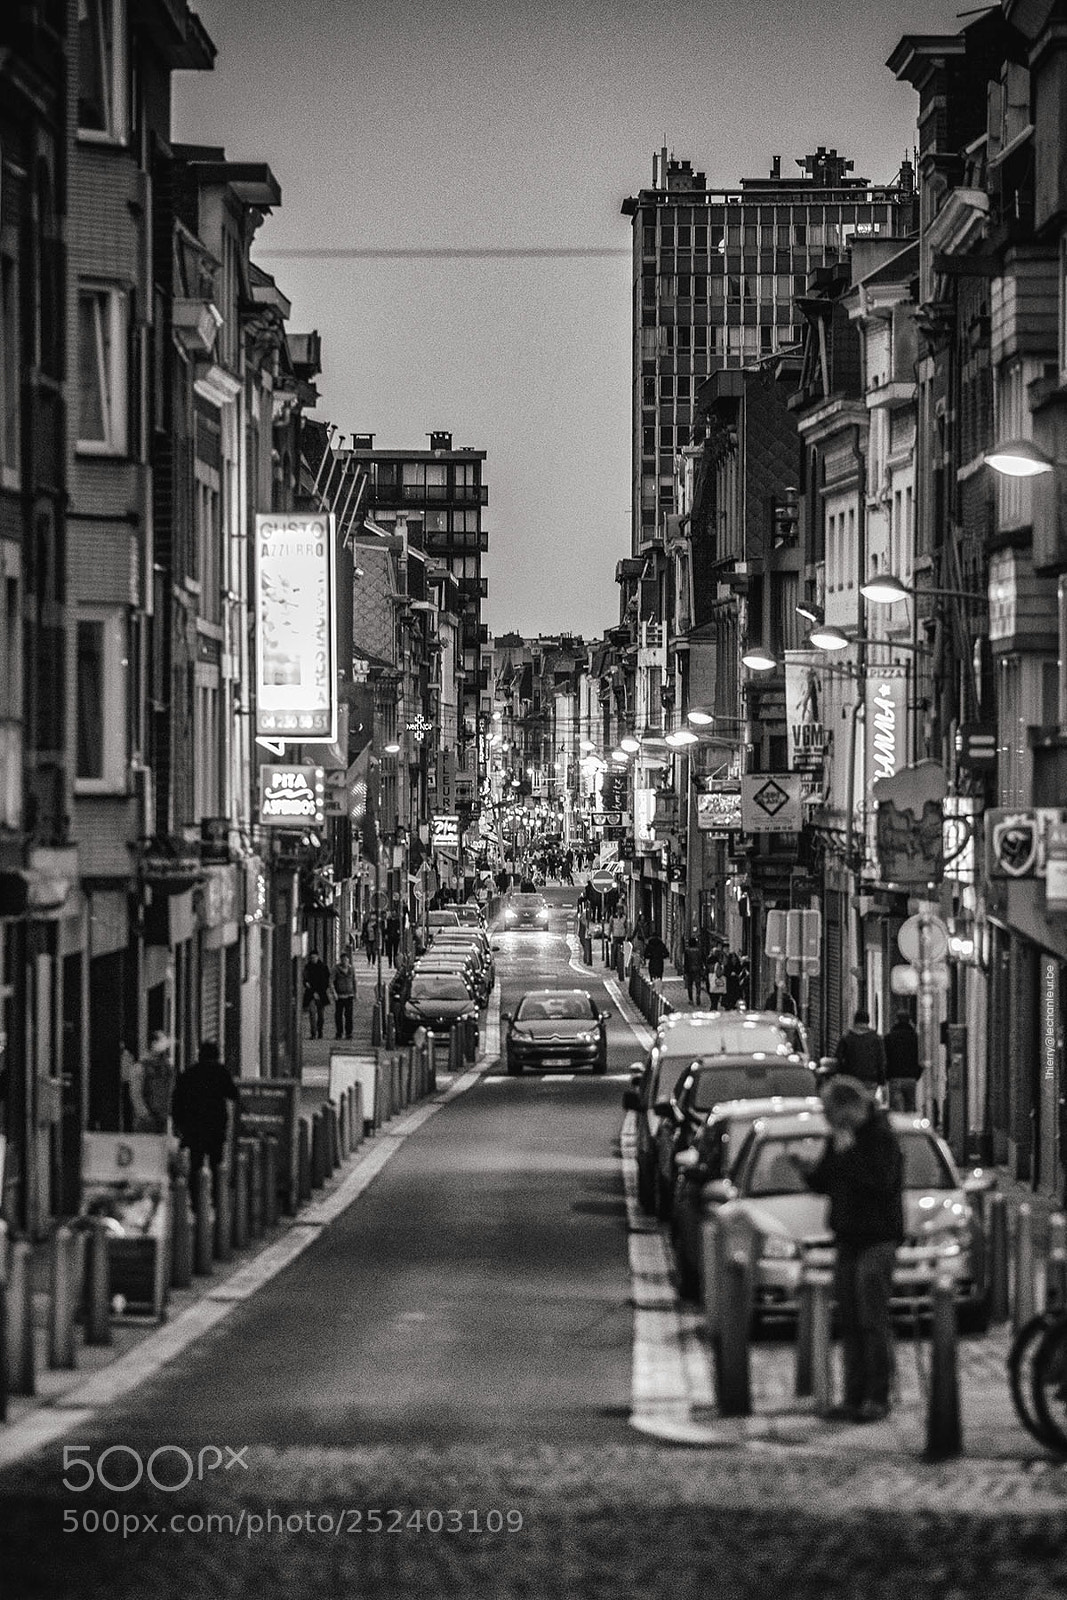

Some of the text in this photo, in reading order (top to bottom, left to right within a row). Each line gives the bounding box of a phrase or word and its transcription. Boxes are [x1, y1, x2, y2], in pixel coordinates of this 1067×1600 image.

[261, 543, 324, 558] AZZRRO
[869, 668, 903, 679] PIZZA
[272, 773, 308, 789] PITA
